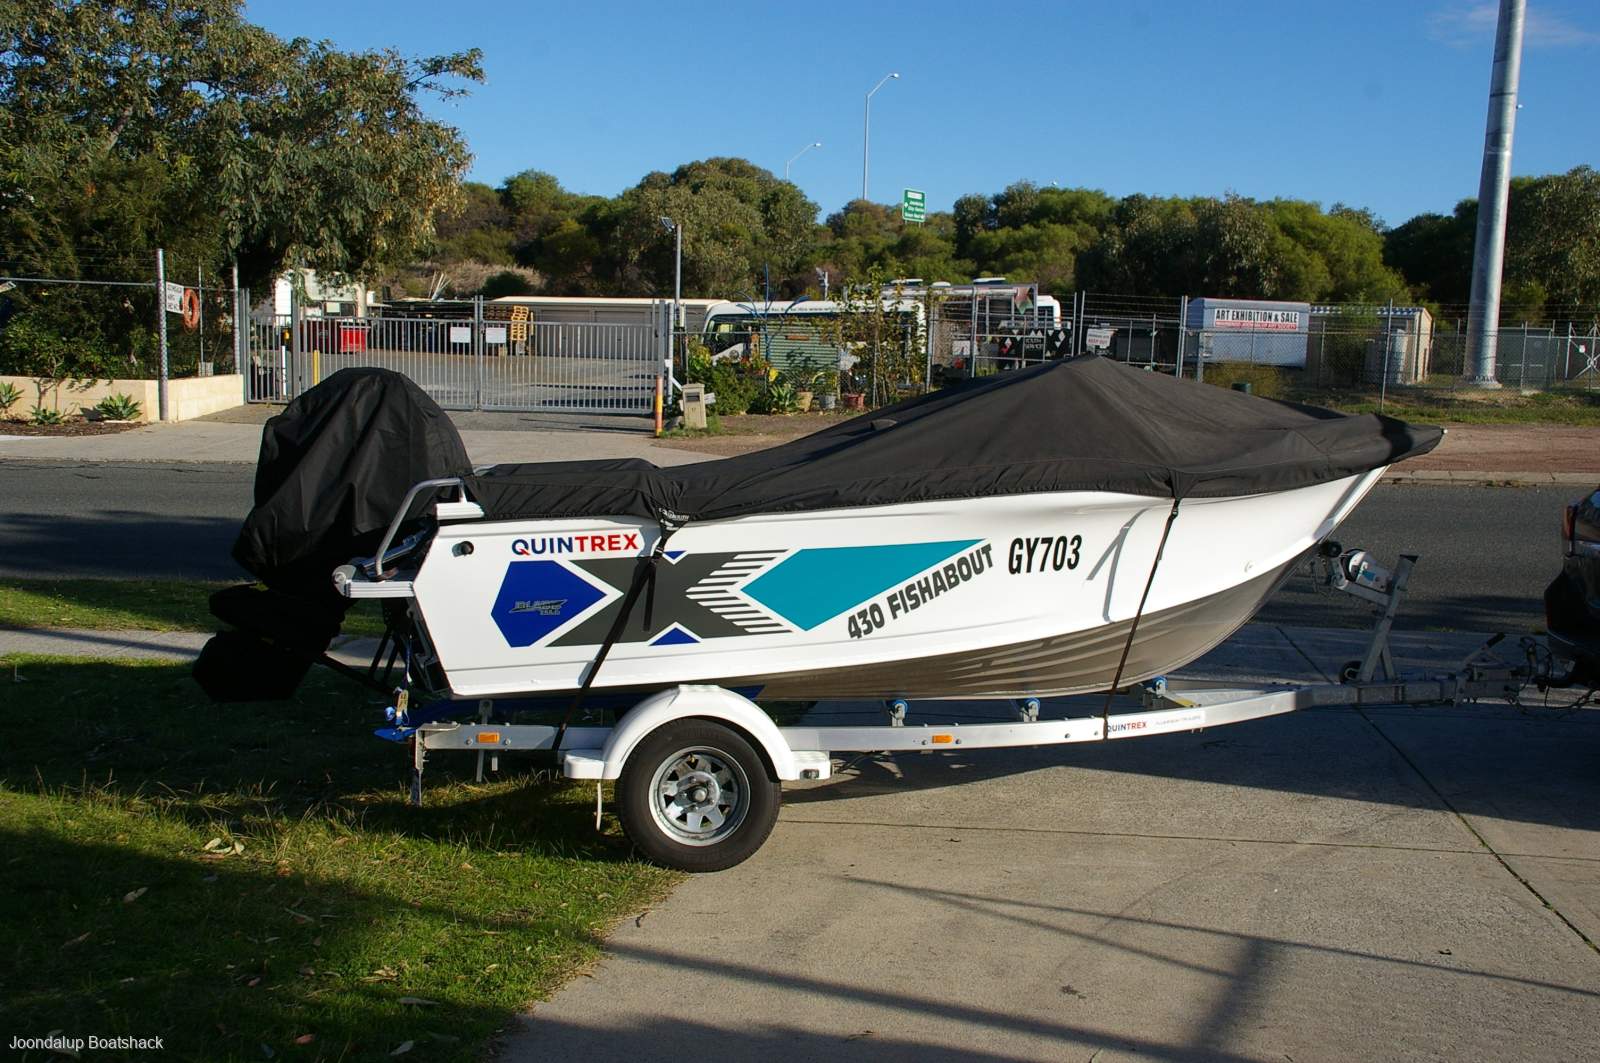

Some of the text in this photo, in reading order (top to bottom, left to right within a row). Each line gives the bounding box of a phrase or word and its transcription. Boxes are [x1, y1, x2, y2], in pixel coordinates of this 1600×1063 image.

[1216, 310, 1231, 320] ART
[1232, 310, 1273, 322] EXHIBITION
[1280, 312, 1298, 323] SALE
[511, 533, 639, 556] QUINTREX
[1008, 534, 1083, 575] GY703
[847, 543, 993, 639] 430 FISHABOUT
